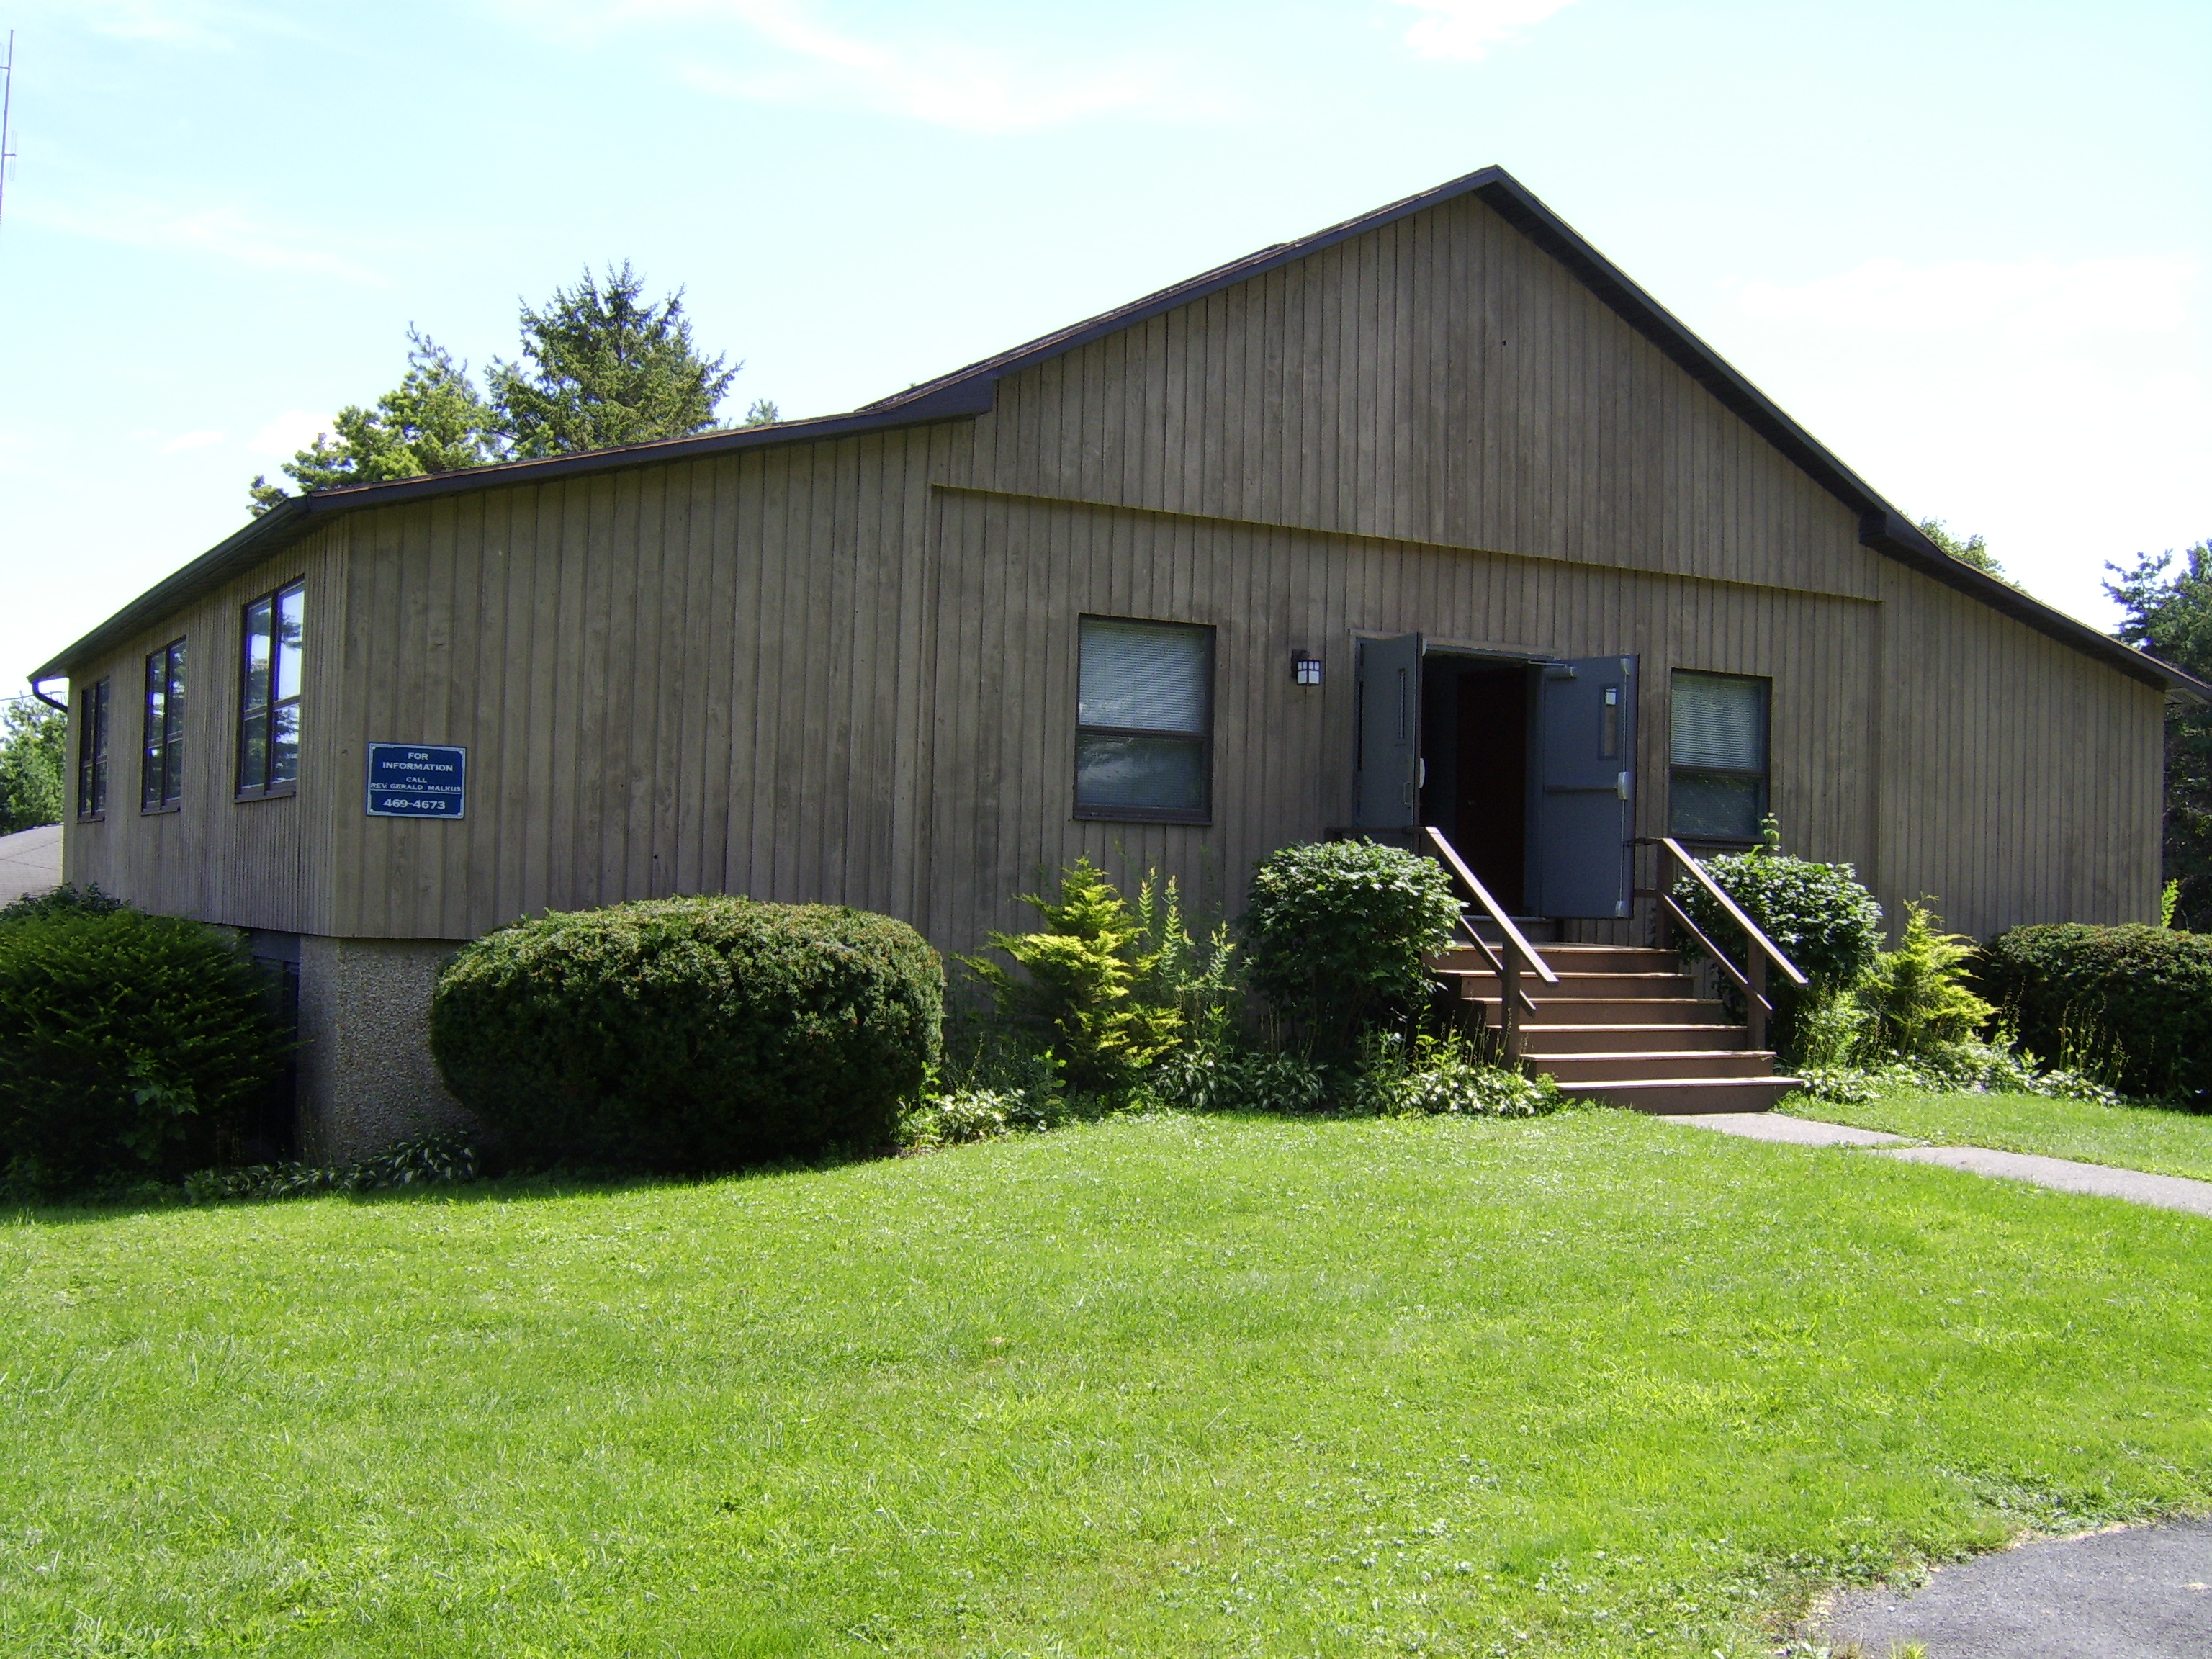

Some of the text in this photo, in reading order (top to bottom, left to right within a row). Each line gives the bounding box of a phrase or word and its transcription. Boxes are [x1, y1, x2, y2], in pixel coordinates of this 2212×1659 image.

[408, 752, 429, 760] FOR
[382, 761, 454, 772] INFORMATION
[382, 799, 446, 810] 469-4673
